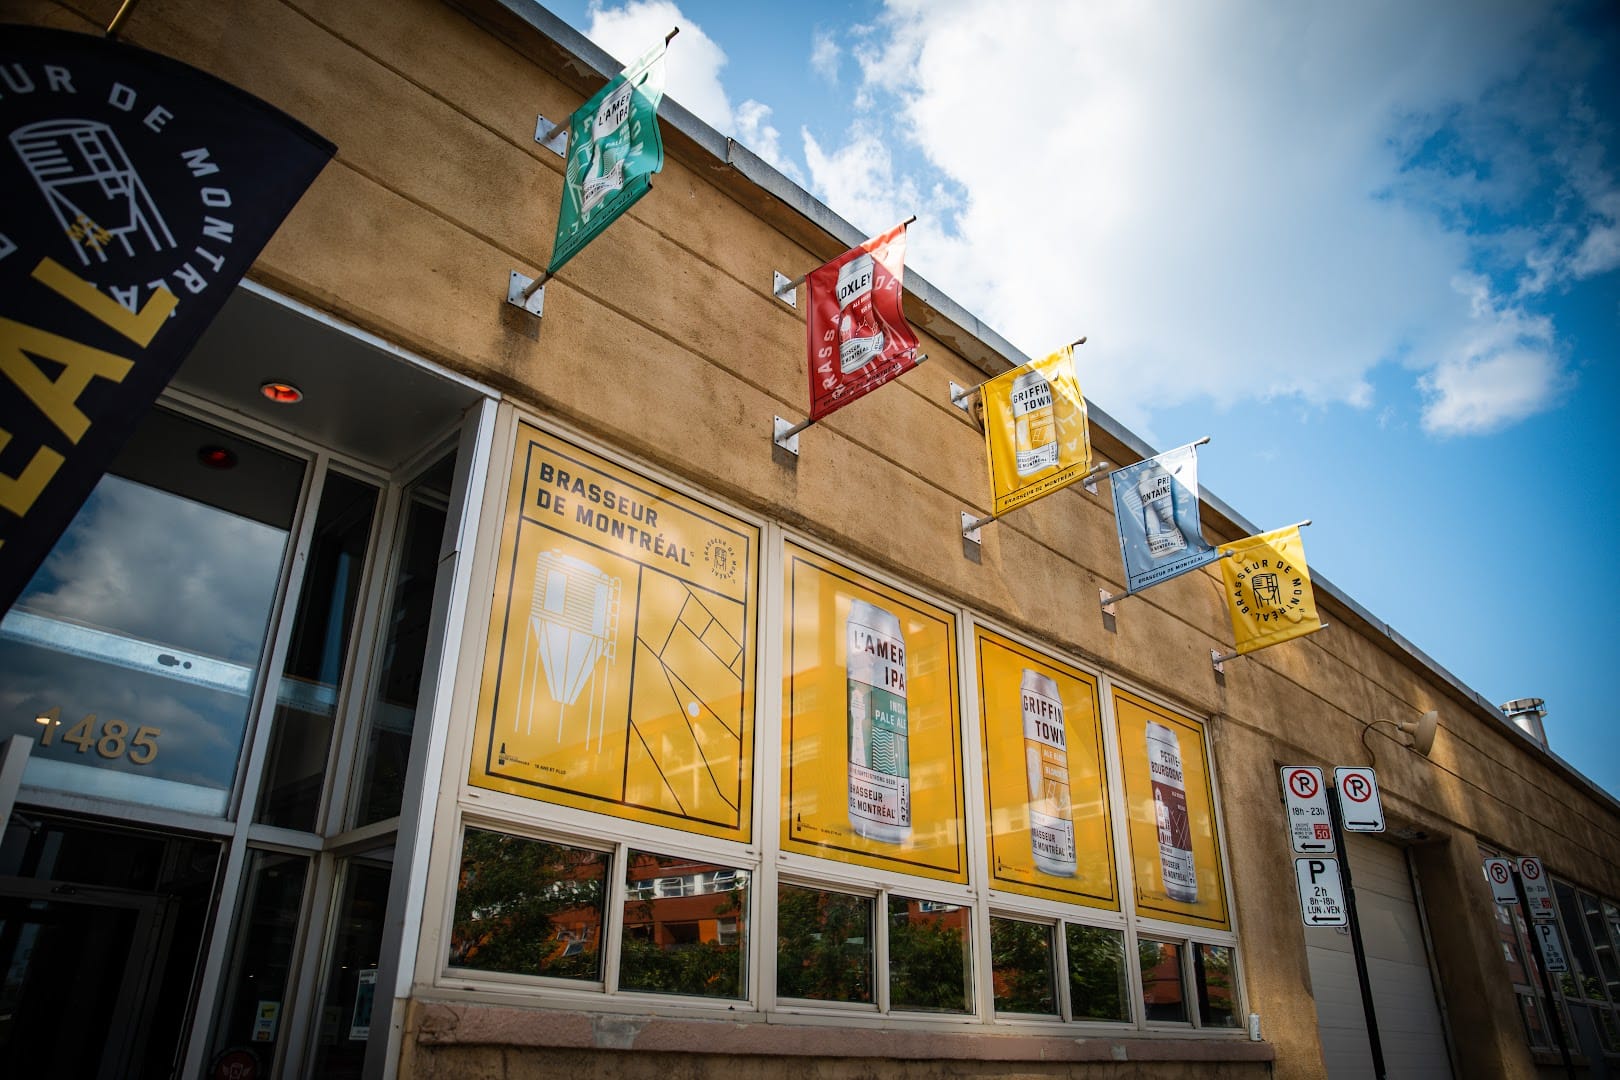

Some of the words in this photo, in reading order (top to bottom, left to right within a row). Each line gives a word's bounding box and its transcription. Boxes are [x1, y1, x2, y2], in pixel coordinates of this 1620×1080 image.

[0, 63, 77, 98] UR
[108, 82, 174, 133] DE
[88, 147, 234, 317] MONTRA
[1013, 382, 1049, 404] GRIFFIN
[1024, 395, 1051, 412] TOWN
[540, 462, 658, 528] BRASSEUR
[1142, 485, 1170, 503] ONTAINE
[536, 488, 565, 516] DE
[576, 504, 691, 567] MONTRÉAL
[1235, 559, 1268, 614] BRASSEUR
[1276, 560, 1292, 574] DE
[854, 629, 904, 667] L'AMER
[885, 666, 905, 692] IPA
[875, 709, 894, 726] PALE
[896, 714, 907, 729] ALE
[1023, 694, 1064, 725] GRIFFIN
[37, 706, 162, 765] 1485
[1034, 720, 1065, 746] TOWN
[849, 783, 883, 803] BRASSEUR
[857, 800, 895, 819] MONTRÉAL
[1315, 830, 1329, 839] 50
[1308, 860, 1326, 884] P
[1307, 905, 1322, 914] LUN
[1541, 925, 1550, 942] P
